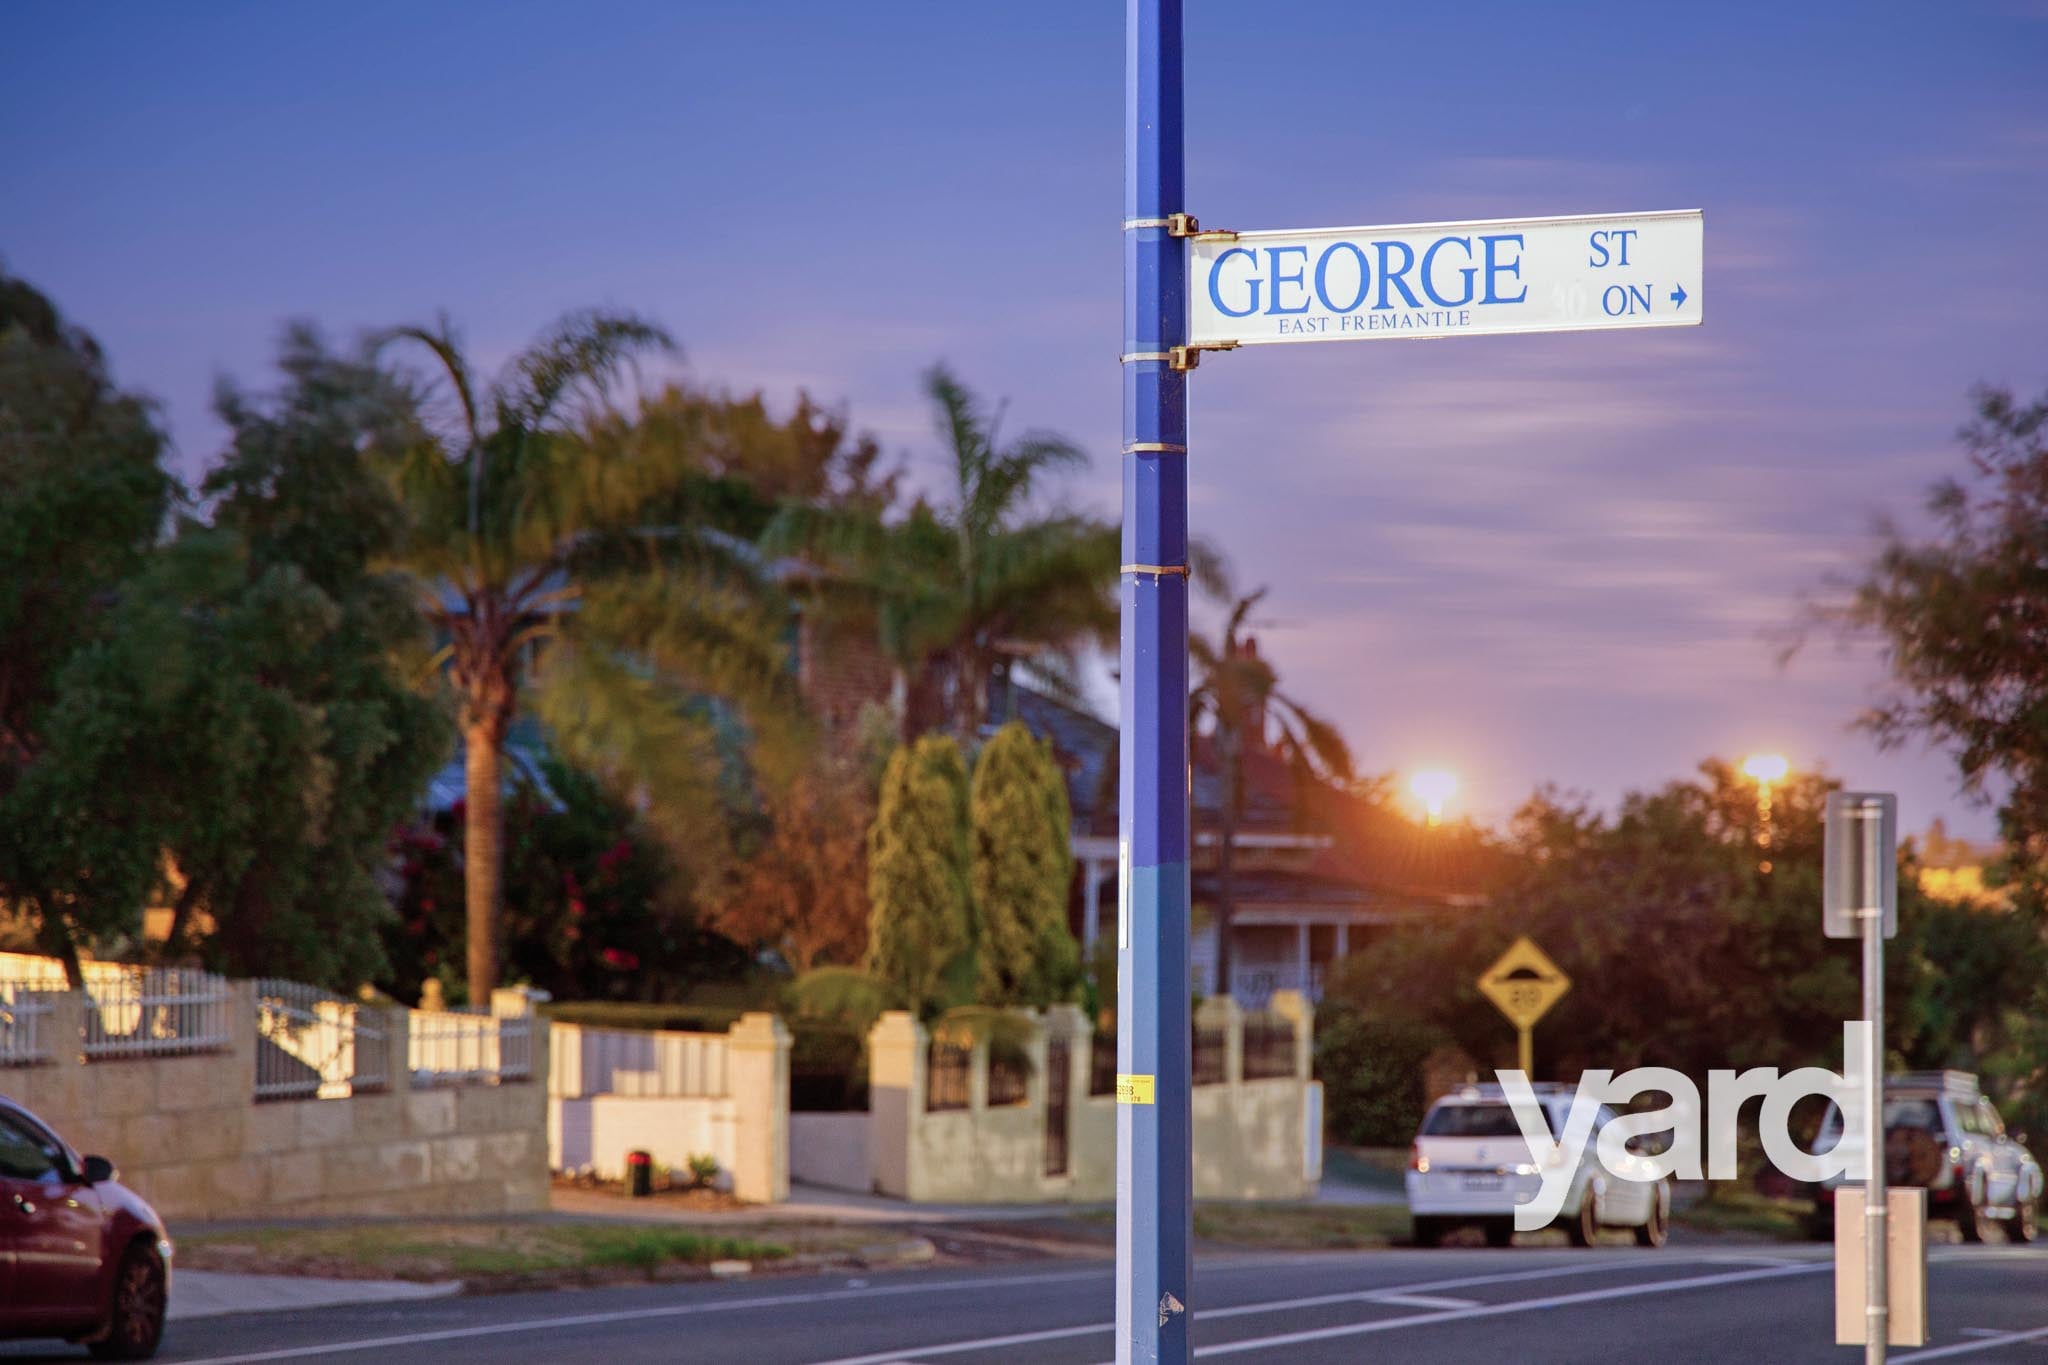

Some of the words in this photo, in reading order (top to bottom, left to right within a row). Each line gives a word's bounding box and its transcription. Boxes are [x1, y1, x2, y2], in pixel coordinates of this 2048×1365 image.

[1208, 234, 1528, 318] GEORGE
[1589, 230, 1638, 268] ST
[1602, 284, 1652, 316] ON
[1277, 316, 1330, 335] EAST
[1340, 310, 1471, 332] FREMANTLE
